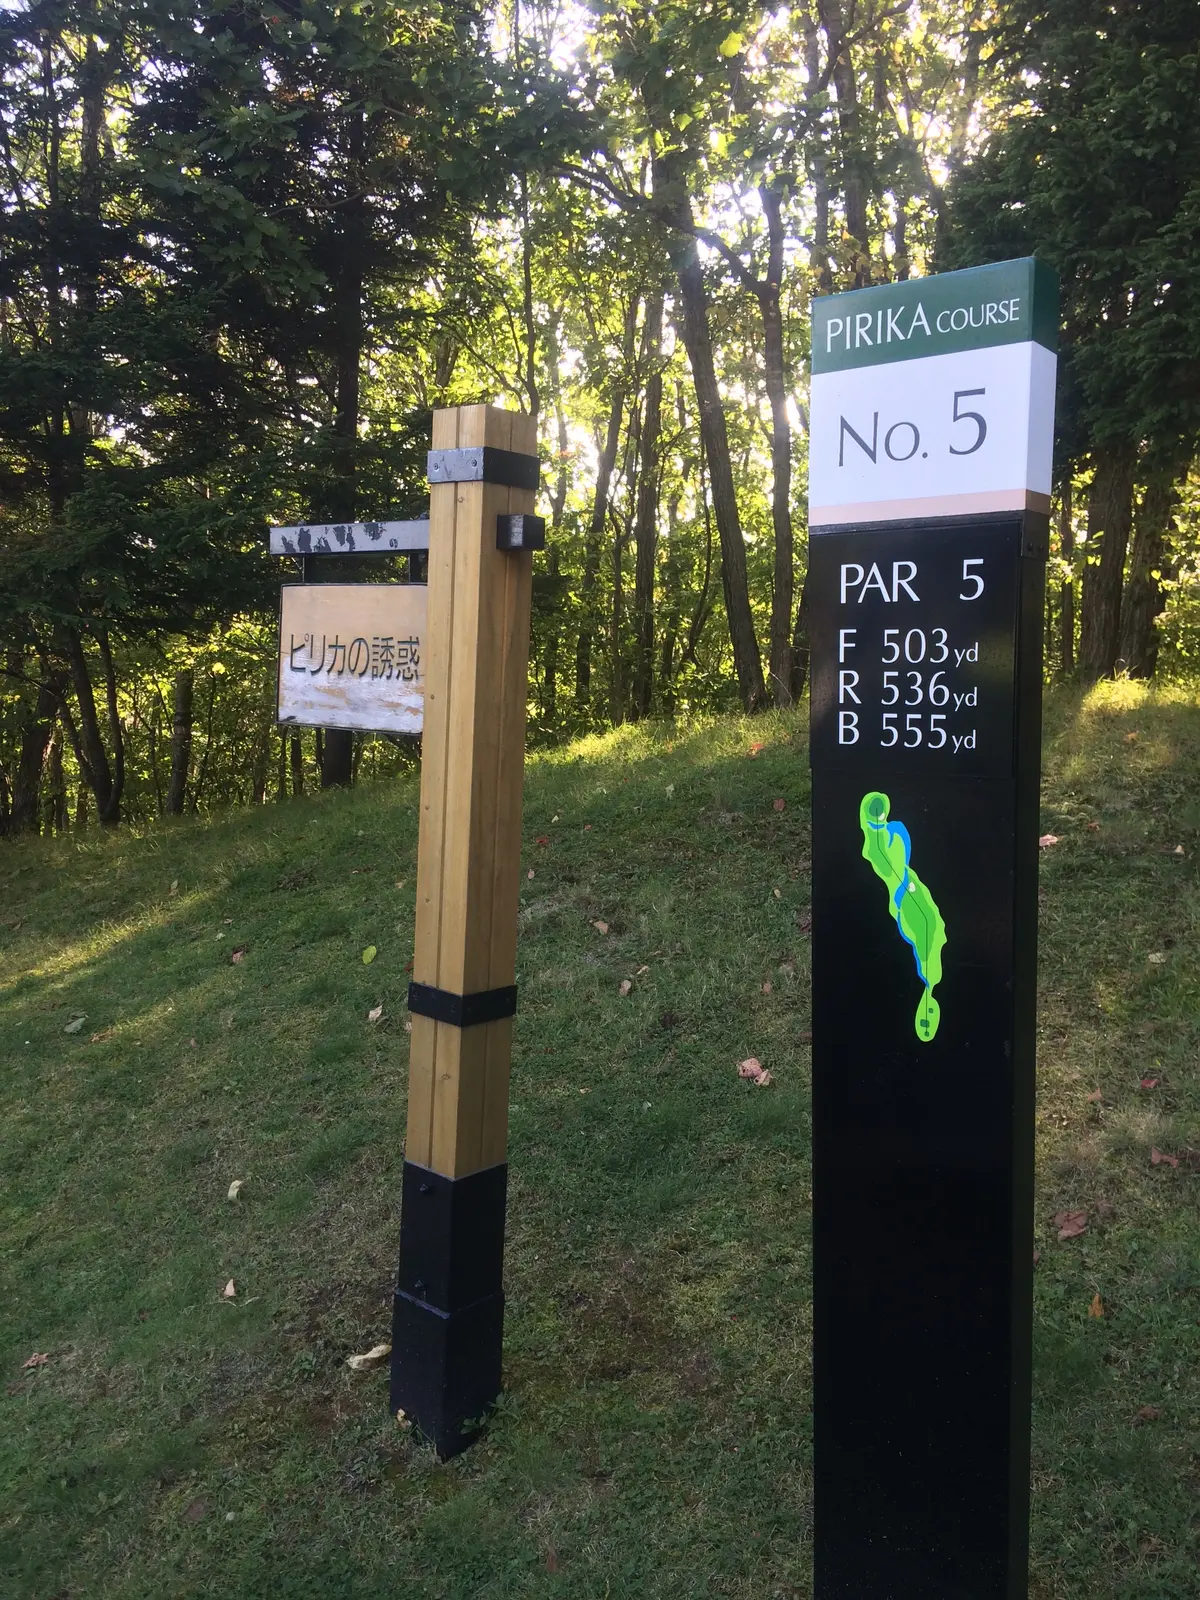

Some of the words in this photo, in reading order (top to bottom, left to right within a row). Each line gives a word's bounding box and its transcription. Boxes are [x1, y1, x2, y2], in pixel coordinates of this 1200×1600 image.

[826, 302, 932, 353] PIRIKA
[936, 298, 1020, 333] COURSE
[838, 411, 928, 467] No.
[949, 387, 987, 455] 5
[840, 560, 921, 604] PAR
[959, 558, 985, 601] 5
[289, 633, 421, 681] ピリカの誘惑
[839, 628, 857, 663] F
[838, 670, 862, 704] R
[838, 711, 860, 745] B
